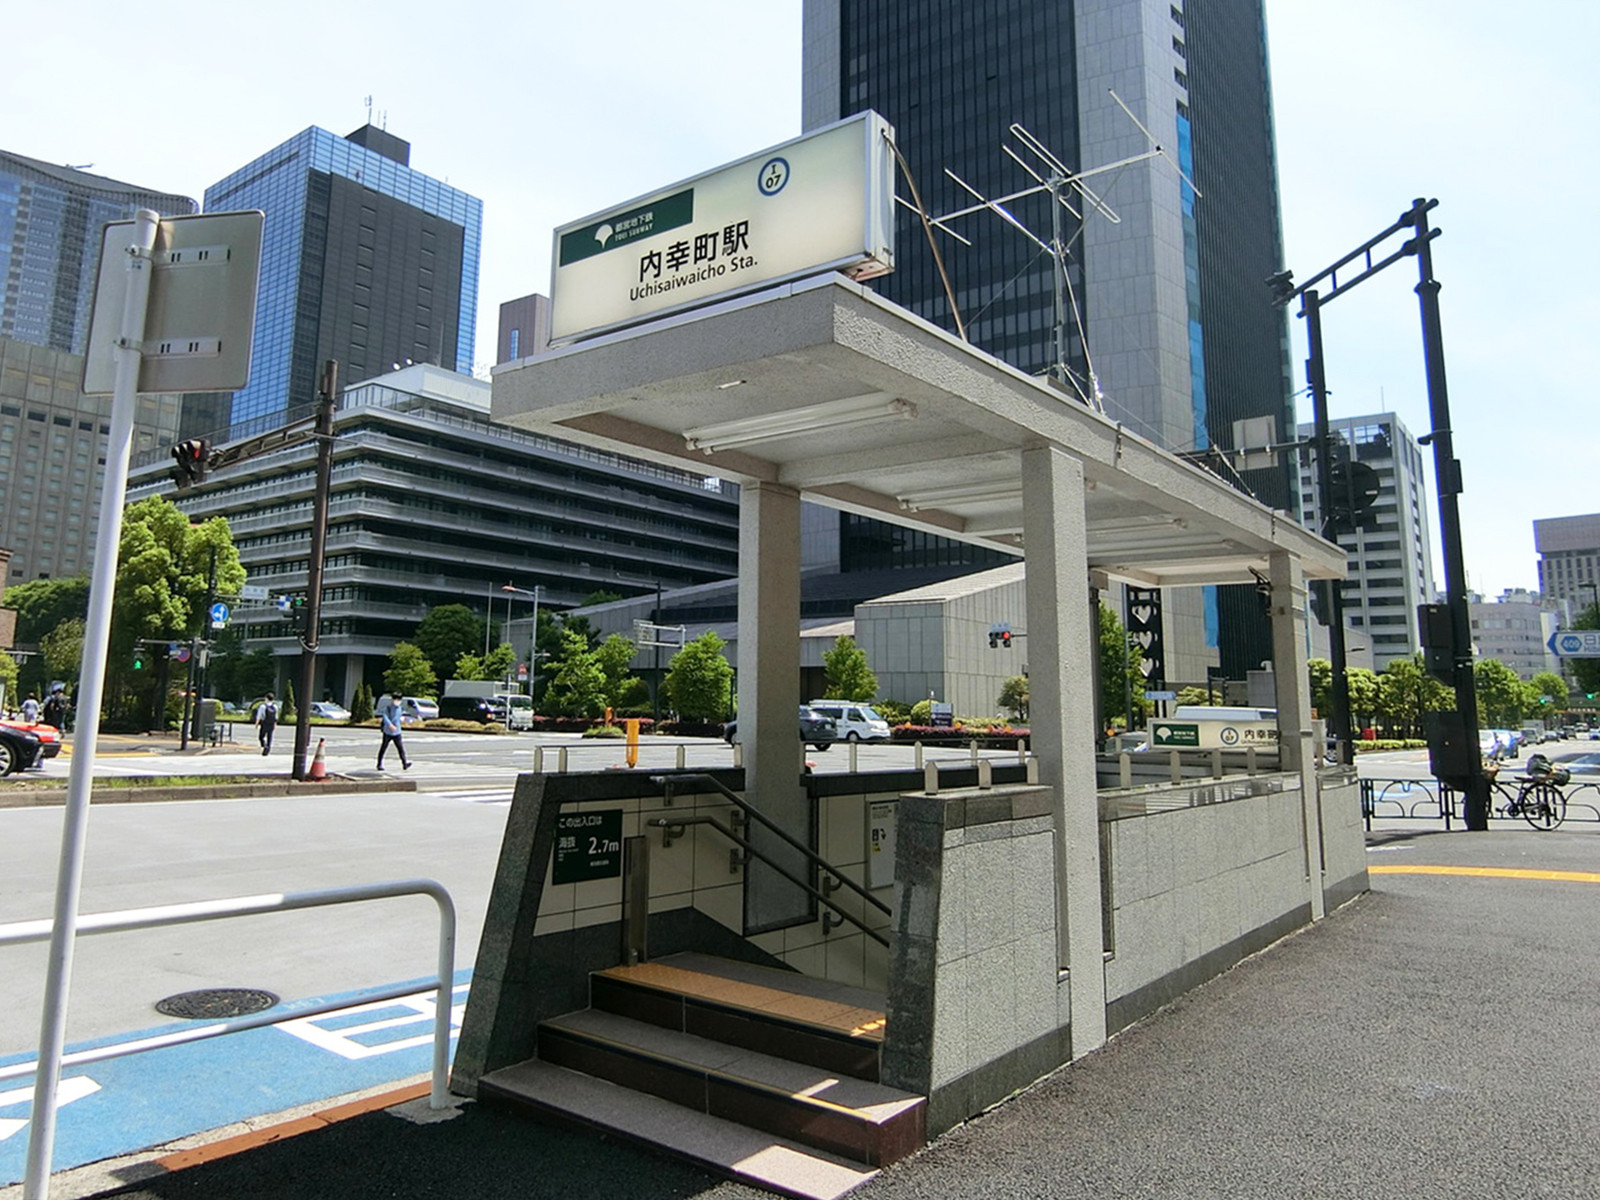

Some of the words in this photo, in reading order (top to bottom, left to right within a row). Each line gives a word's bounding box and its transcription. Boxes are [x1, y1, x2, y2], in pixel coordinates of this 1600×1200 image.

[766, 174, 781, 188] 07
[615, 211, 654, 233] 都営地下鉄
[629, 223, 654, 238] SUBWAY
[640, 220, 749, 282] 内幸町駅
[629, 264, 726, 301] Uchisaiwaicho
[730, 255, 758, 272] Sta.
[559, 816, 602, 828] この出入口は
[588, 836, 620, 855] 2.7m
